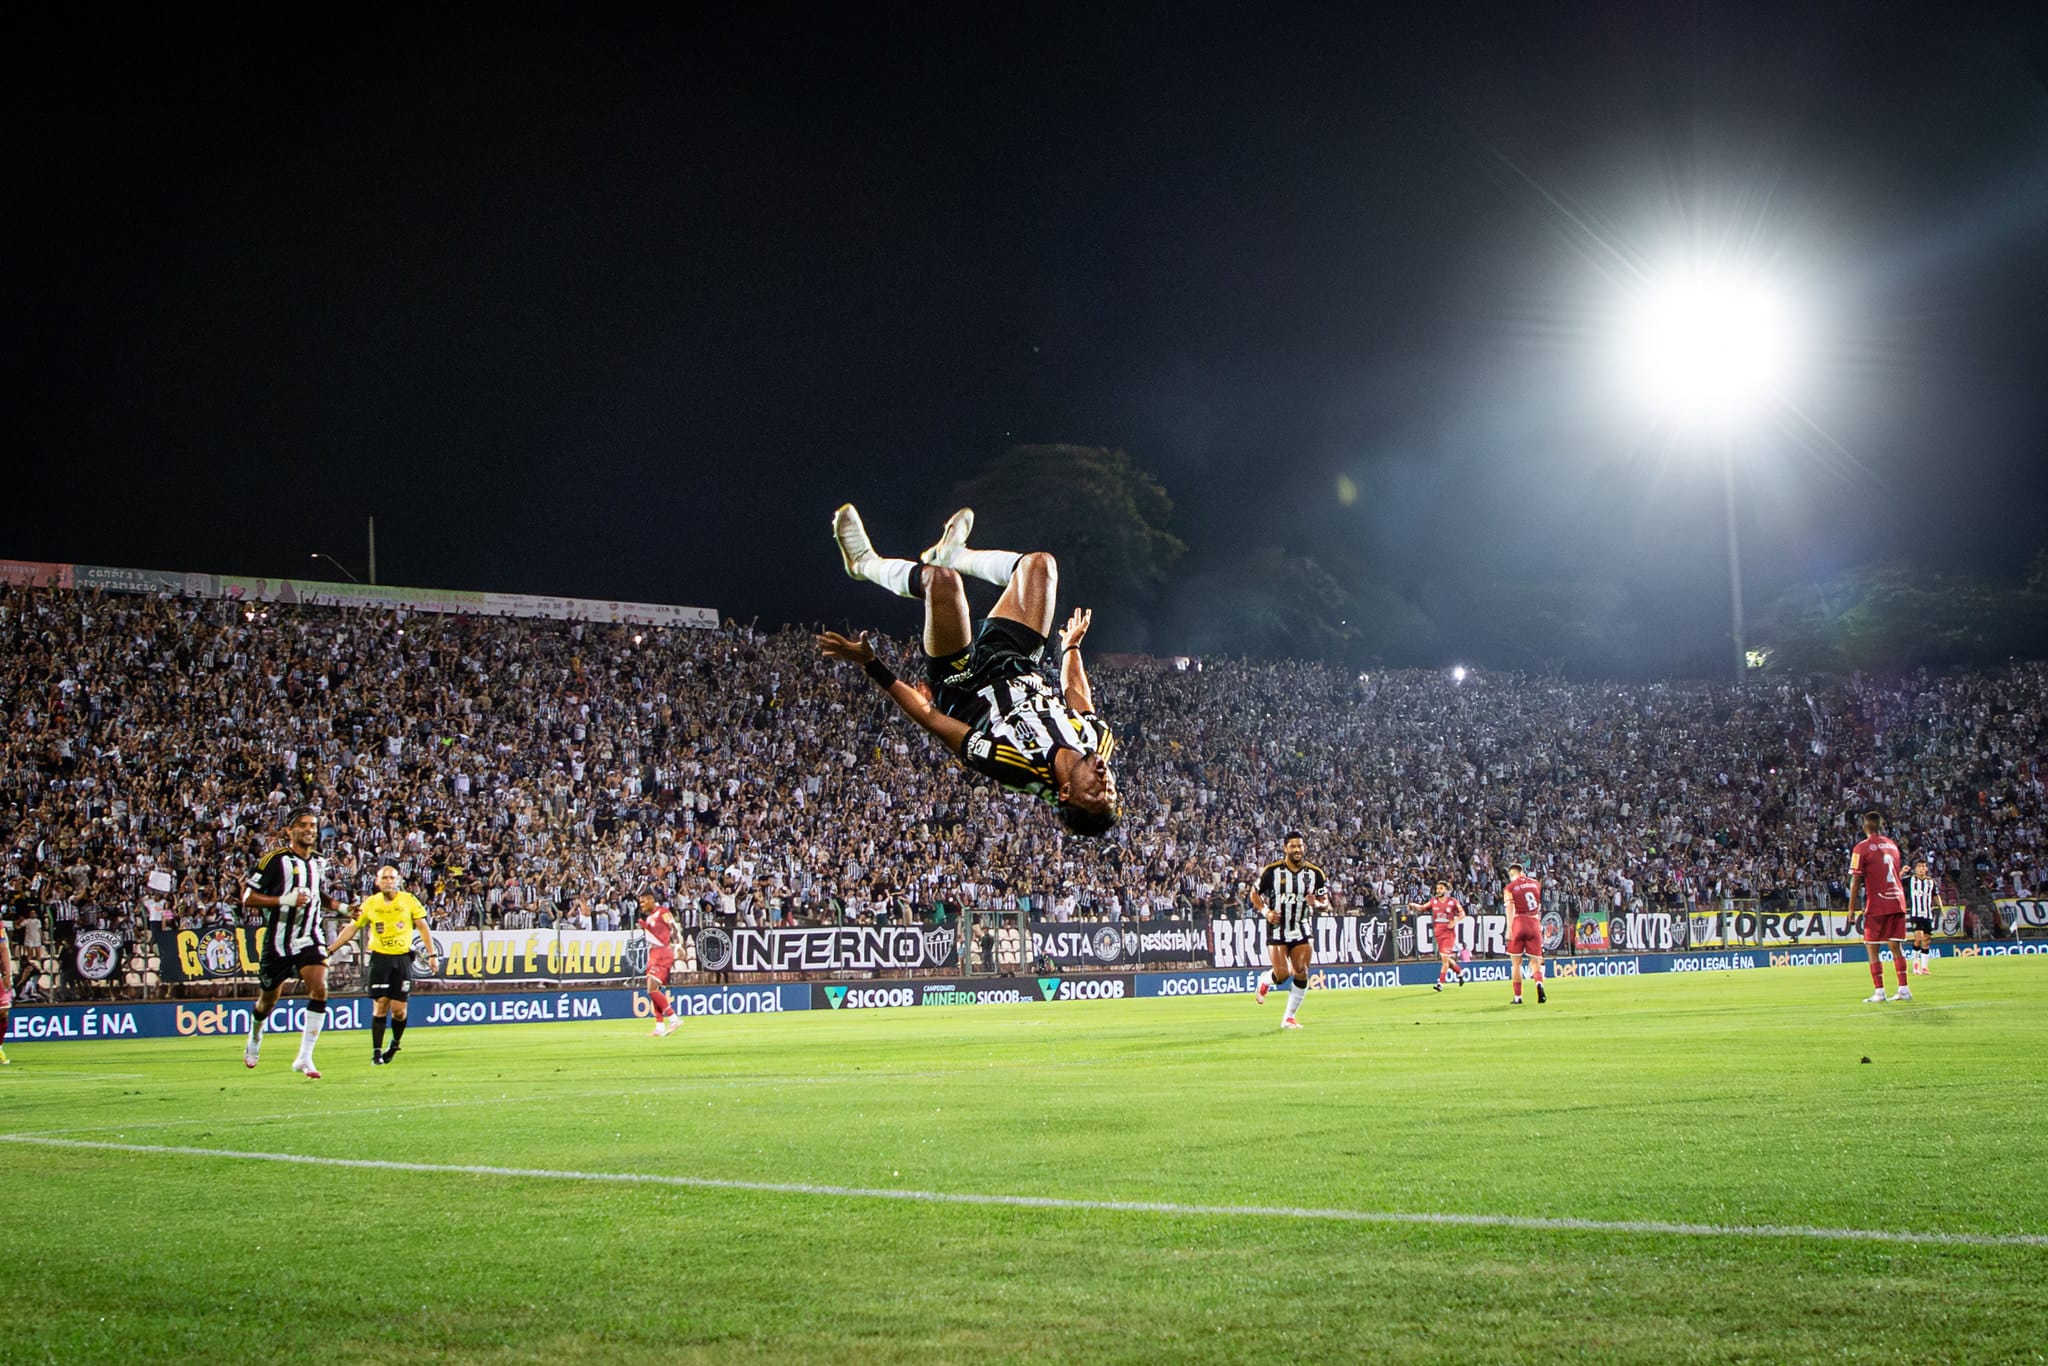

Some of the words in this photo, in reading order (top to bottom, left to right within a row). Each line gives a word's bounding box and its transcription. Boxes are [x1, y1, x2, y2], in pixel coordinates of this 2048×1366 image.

[1524, 891, 1538, 911] 8
[79, 931, 118, 946] MOTOGALO
[1625, 913, 1673, 949] MVB
[1715, 911, 1826, 943] FORÇA
[732, 927, 925, 971] INFERNO
[1032, 932, 1094, 957] RASTA
[1212, 916, 1363, 967] BRIDA
[446, 940, 514, 978] AQUI
[524, 933, 539, 973] É
[547, 940, 623, 974] GALO!
[1553, 956, 1641, 978] betnacional
[1670, 958, 1700, 972] JOGO
[1700, 956, 1732, 970] LEGAL
[1732, 953, 1739, 969] É
[1740, 955, 1755, 969] NA
[1769, 949, 1843, 968] betnacional
[1158, 979, 1199, 996] JOGO
[1201, 976, 1246, 993] LEGAL
[1247, 971, 1255, 990] É
[1309, 966, 1402, 990] etnacional
[1473, 966, 1509, 980] LEGAL
[847, 988, 914, 1008] SICOOB
[922, 991, 976, 1006] MINEIRO
[977, 989, 1020, 1005] SICOOB
[1060, 980, 1125, 1000] SICOOB
[426, 1001, 487, 1023] JOGO
[490, 999, 554, 1021] LEGAL
[557, 993, 570, 1018] É
[573, 998, 602, 1018] NA
[83, 1007, 98, 1035] É
[102, 1012, 138, 1034] NA
